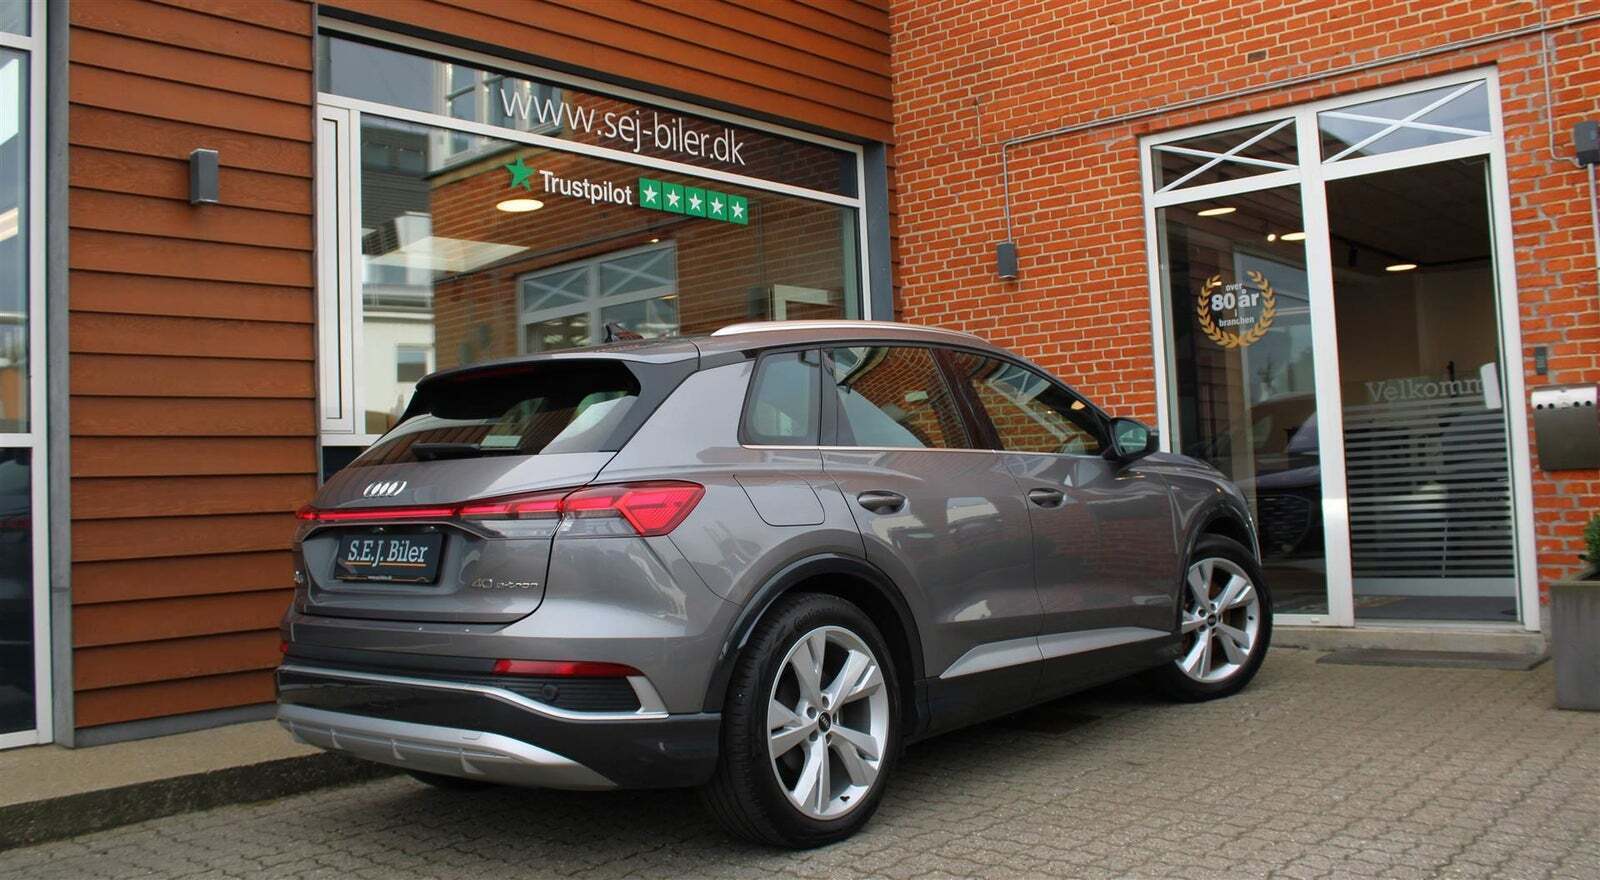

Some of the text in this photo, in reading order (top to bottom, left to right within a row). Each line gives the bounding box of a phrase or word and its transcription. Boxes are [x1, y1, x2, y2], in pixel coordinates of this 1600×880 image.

[500, 88, 747, 166] www.sej-biler.dk
[538, 169, 633, 206] Trustpilot
[1225, 283, 1243, 292] over
[1211, 288, 1260, 312] 80 år
[1218, 316, 1255, 328] branchen
[347, 540, 428, 567] S.E.J. Biler
[471, 577, 493, 589] 40
